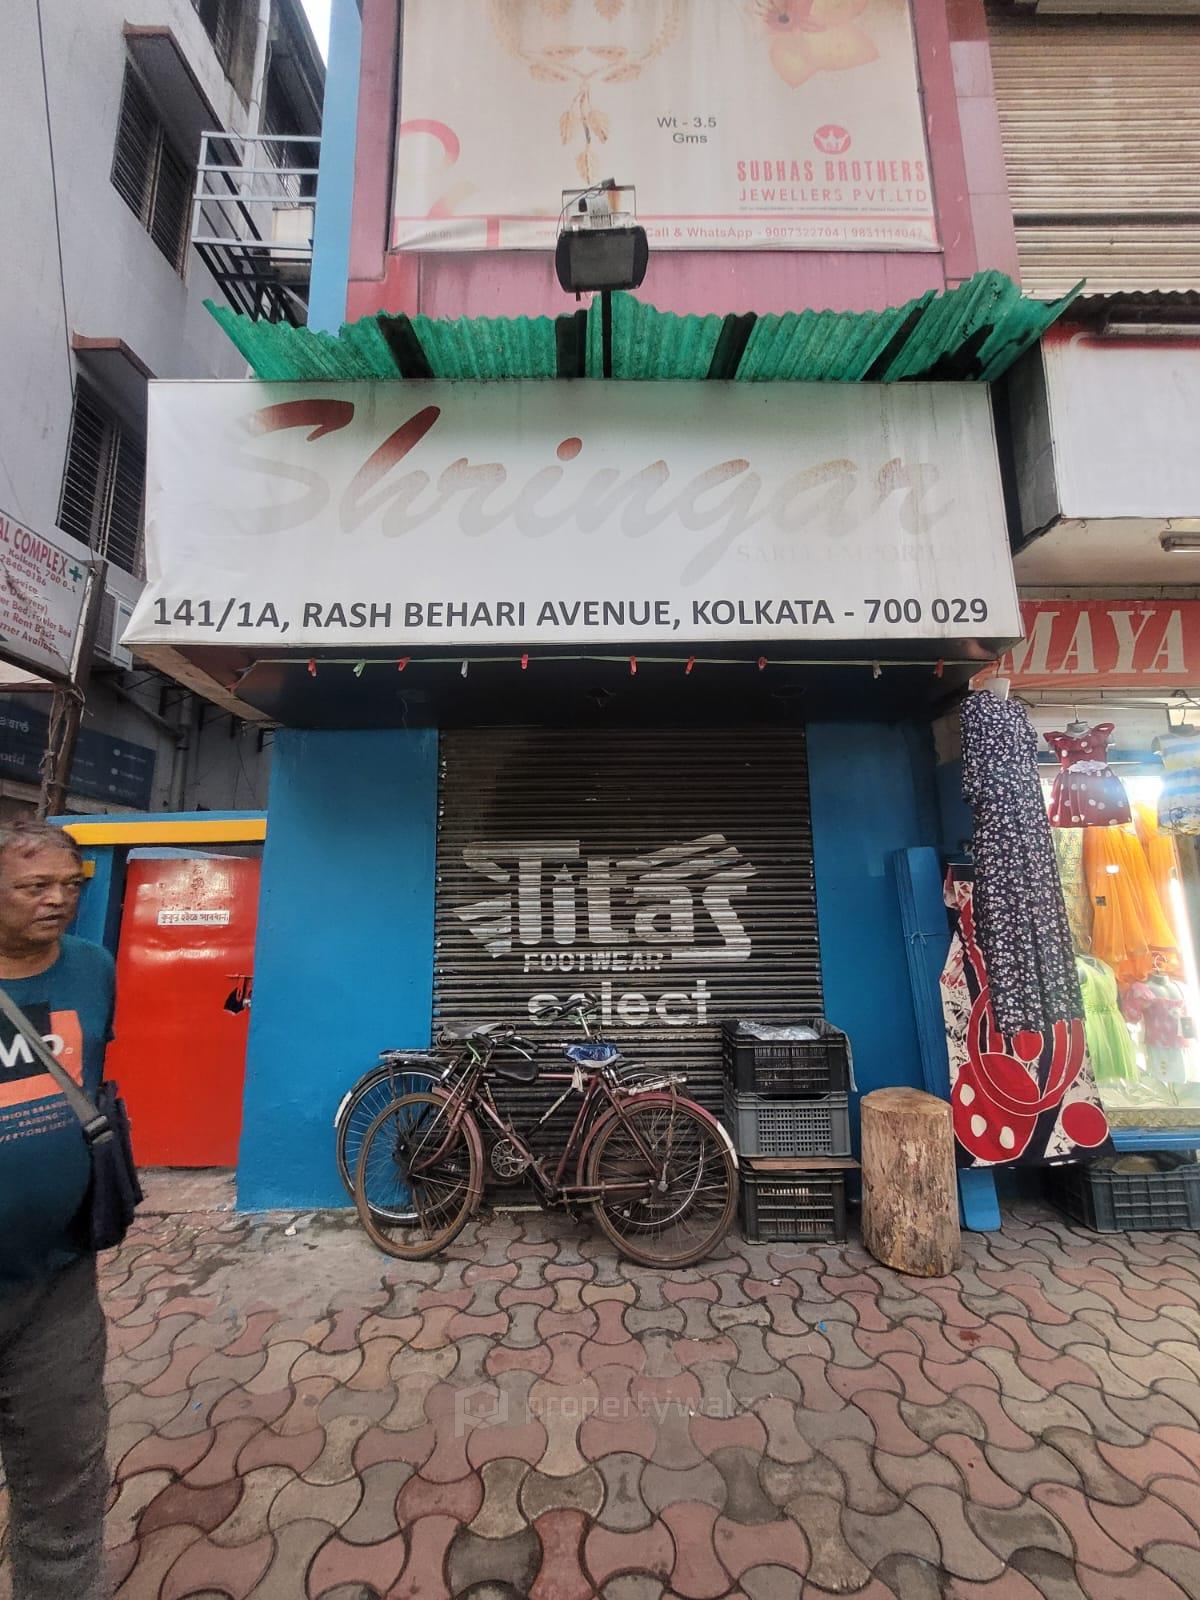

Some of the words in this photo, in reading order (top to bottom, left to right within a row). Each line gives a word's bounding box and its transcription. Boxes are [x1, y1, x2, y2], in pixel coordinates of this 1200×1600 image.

[656, 117, 678, 128] Wt
[693, 116, 717, 128] 3.5
[671, 133, 708, 144] Gms
[736, 160, 814, 182] SUBHAS
[826, 160, 926, 182] BROTHERS
[738, 188, 843, 202] JEWELLERS
[852, 188, 927, 202] PVT.LTD
[673, 227, 683, 238] &
[686, 226, 753, 241] WhatsApp
[14, 527, 68, 578] COMPLEX
[153, 596, 290, 633] 141/1A,
[302, 602, 392, 629] RASH
[403, 601, 525, 628] BEHARI
[536, 600, 681, 630] AVENUE,
[692, 599, 835, 625] KOLKATA
[864, 599, 922, 624] 700
[931, 598, 988, 623] 029
[991, 609, 1190, 676] MAYA
[523, 950, 665, 973] FOOTWEAR
